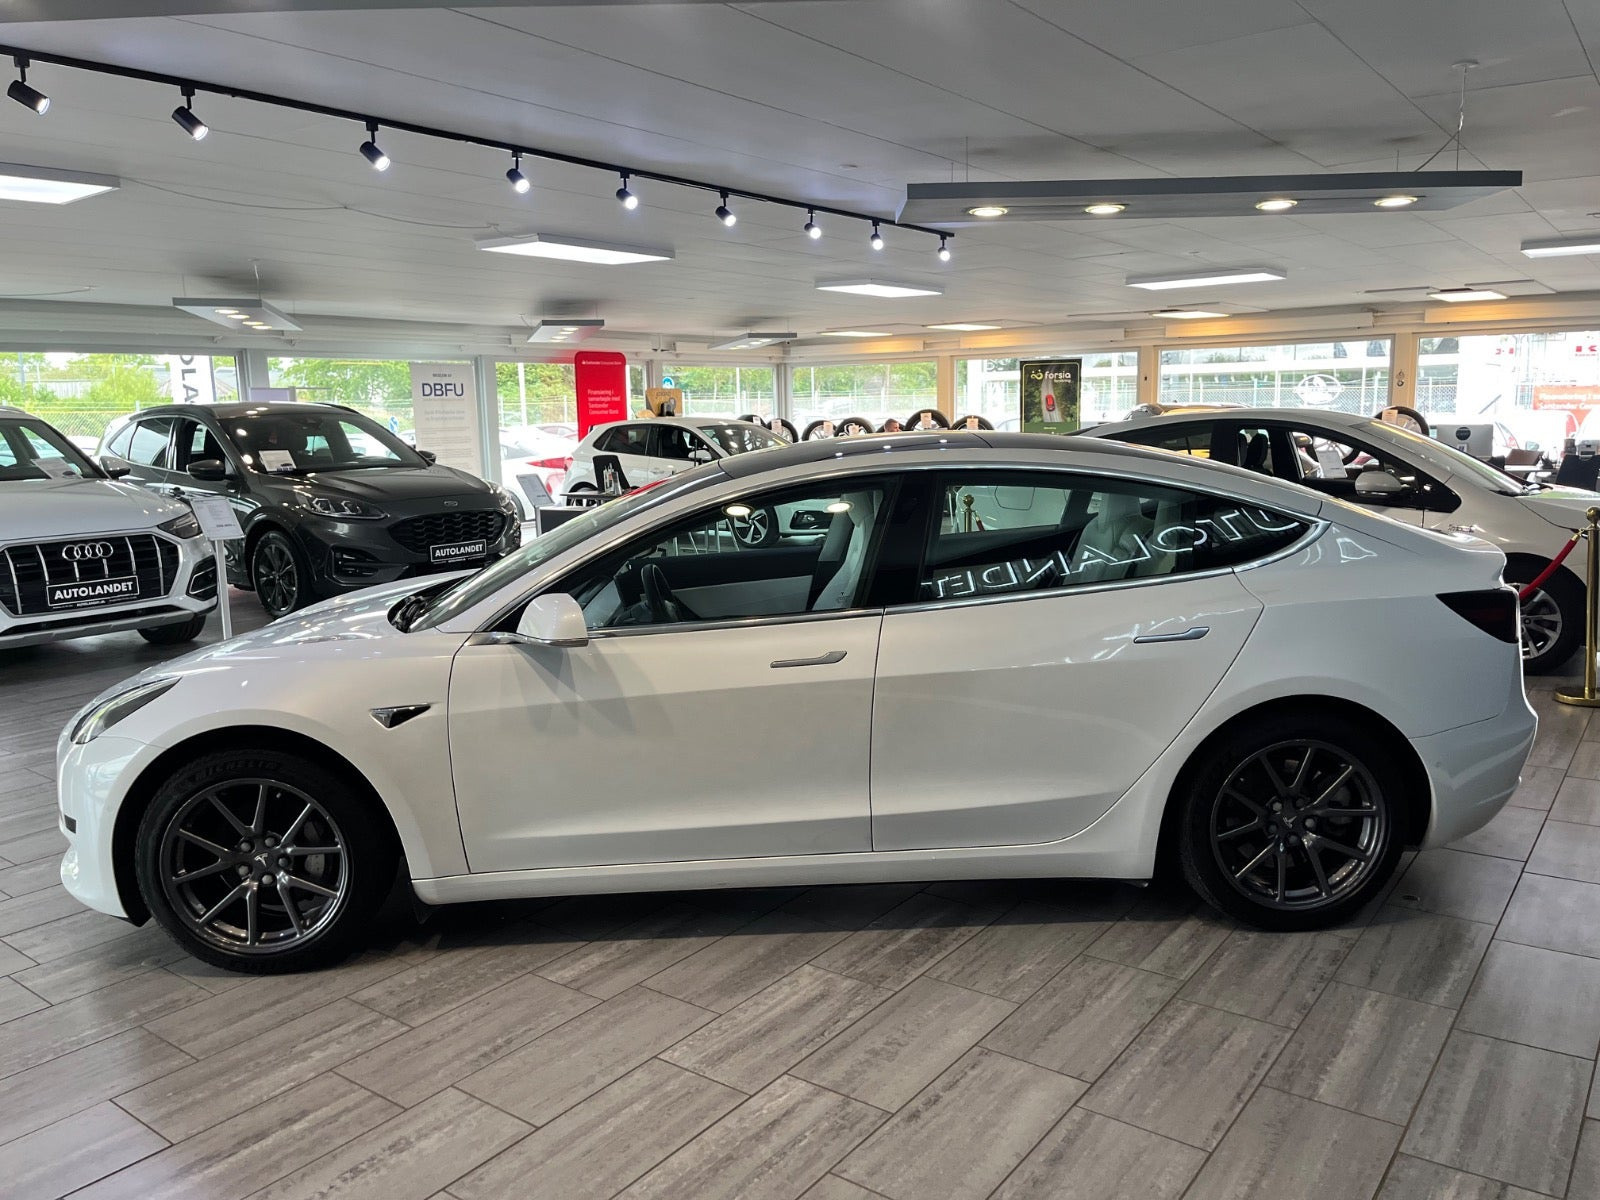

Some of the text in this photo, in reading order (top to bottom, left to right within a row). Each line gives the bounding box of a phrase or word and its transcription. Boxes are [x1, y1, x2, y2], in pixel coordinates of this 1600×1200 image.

[1045, 371, 1071, 379] forsia
[421, 382, 464, 397] DBFU
[434, 544, 484, 557] AUTOLANDET
[54, 581, 134, 600] AUTOLANDET
